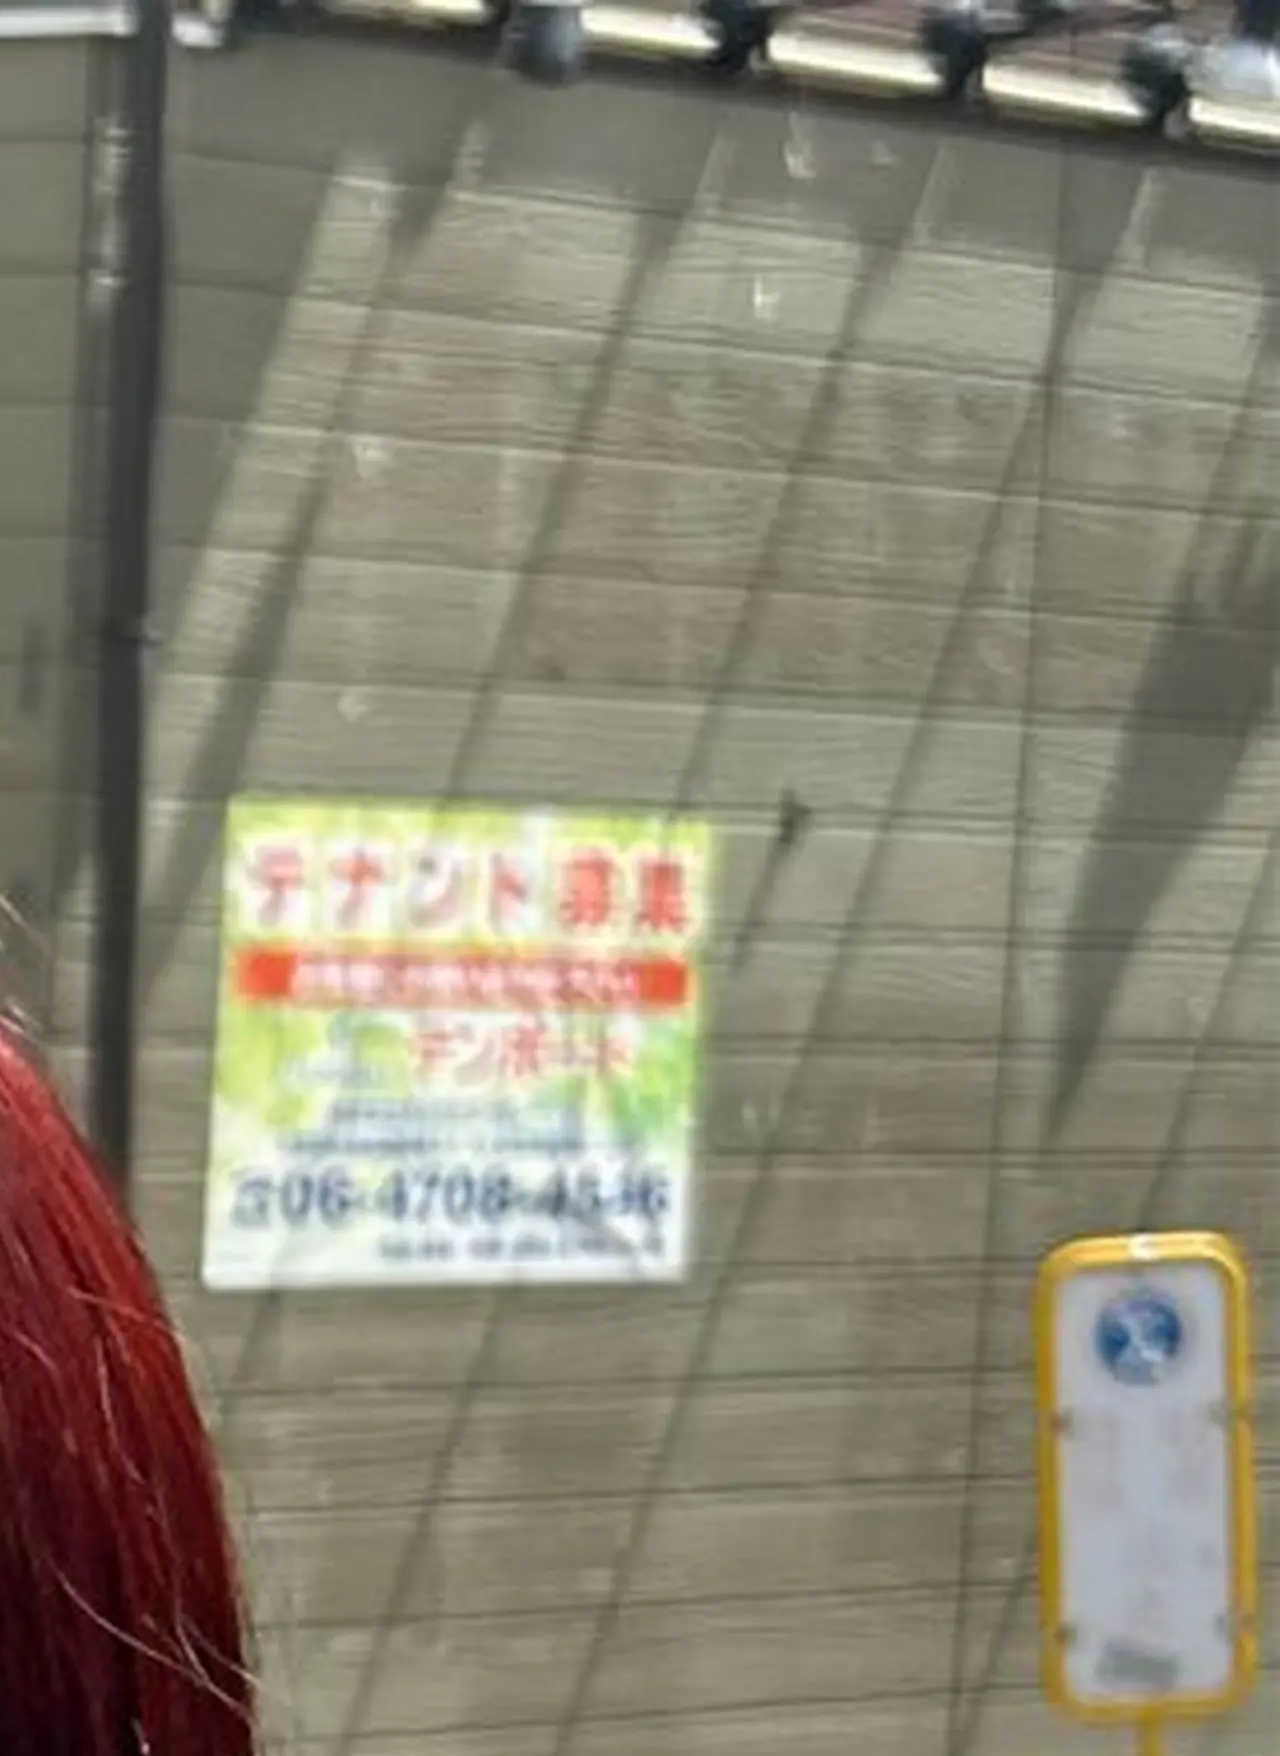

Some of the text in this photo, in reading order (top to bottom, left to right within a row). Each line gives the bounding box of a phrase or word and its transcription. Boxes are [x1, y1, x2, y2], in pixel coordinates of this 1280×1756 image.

[242, 841, 690, 933] テナント募集
